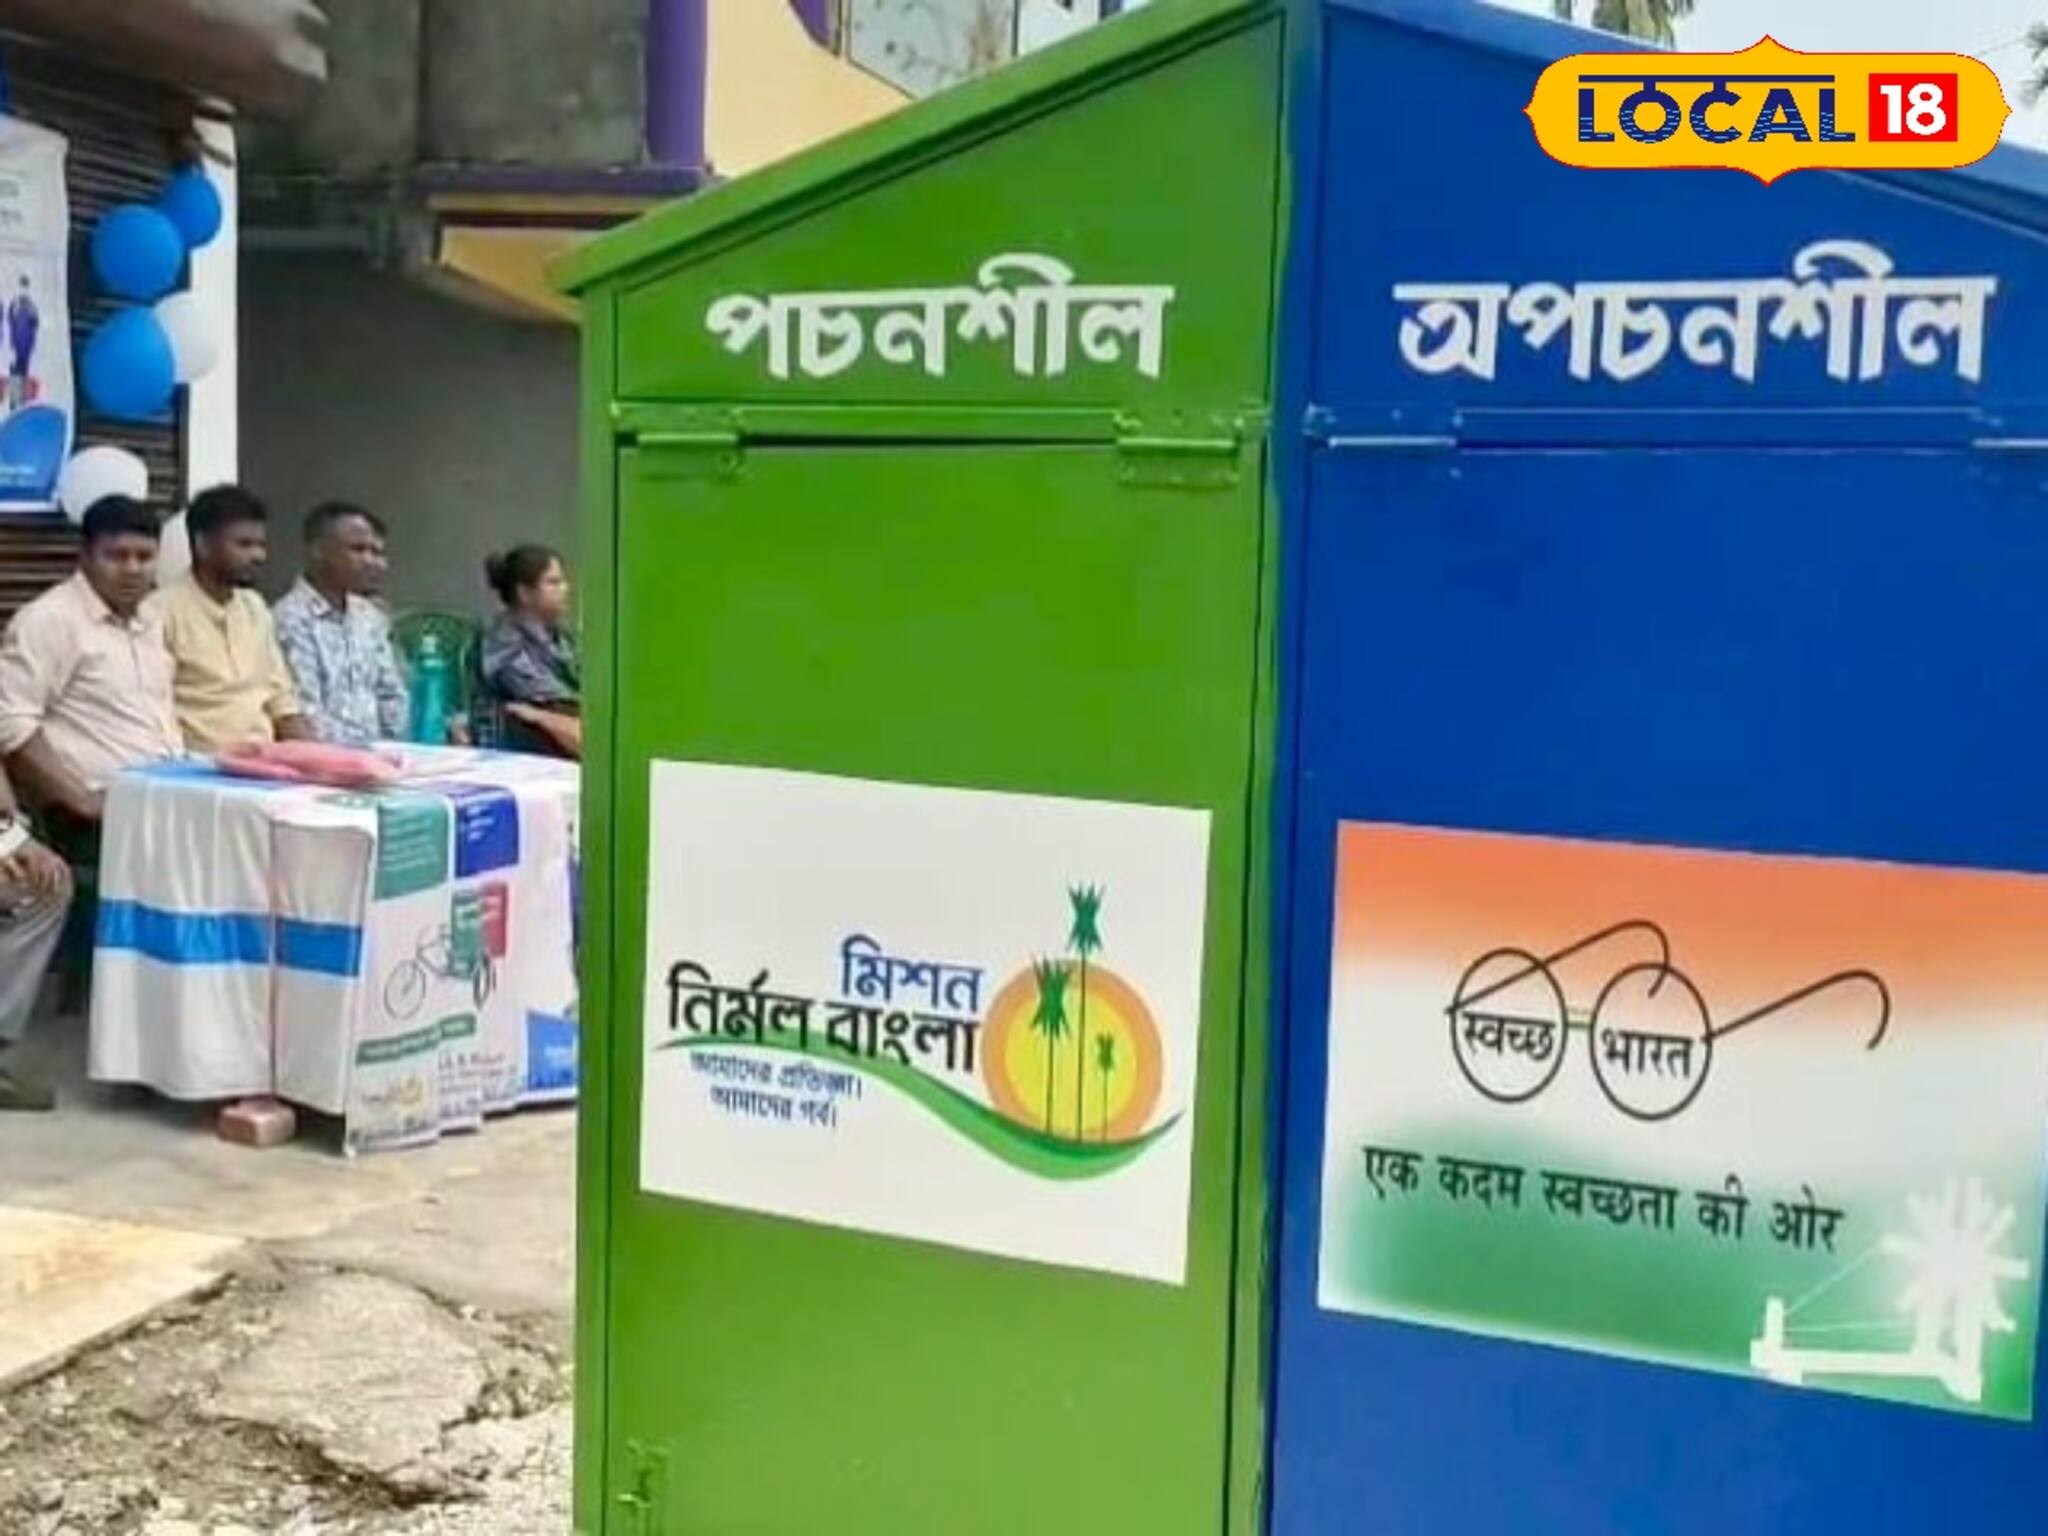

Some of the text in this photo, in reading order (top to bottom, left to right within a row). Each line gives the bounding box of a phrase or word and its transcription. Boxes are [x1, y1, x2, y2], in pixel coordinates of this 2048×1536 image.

[705, 252, 1175, 380] পচনশীল
[1393, 239, 1997, 382] অপচনশীল
[666, 960, 980, 1073] নির্মল বাংলা
[840, 934, 982, 1013] মিশন
[1463, 1011, 1556, 1062] स्वच्छ
[1602, 1026, 1693, 1078] भारत
[1363, 1146, 1845, 1253] एक कदम स्वच्छता की ओर
